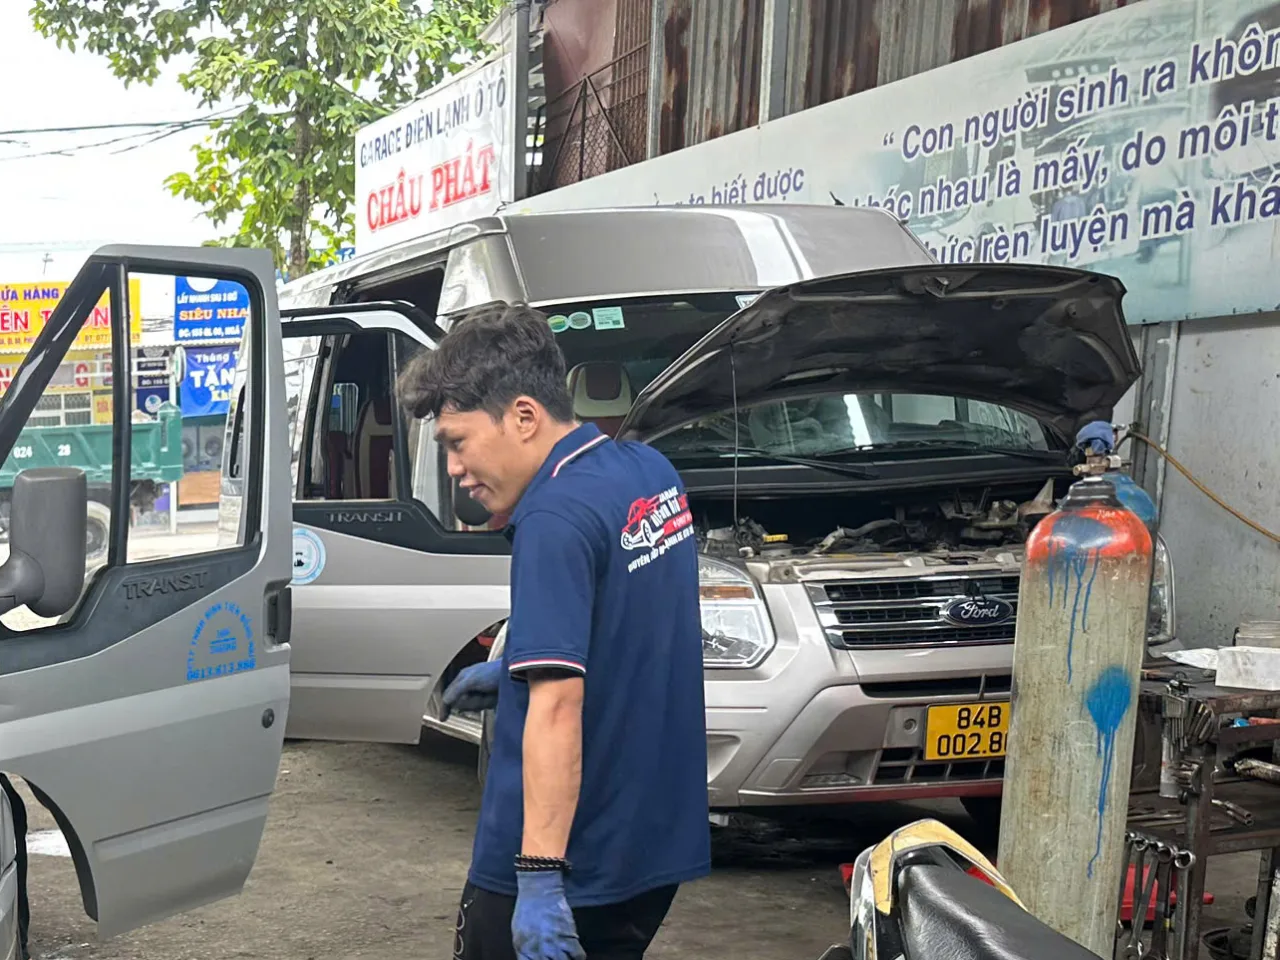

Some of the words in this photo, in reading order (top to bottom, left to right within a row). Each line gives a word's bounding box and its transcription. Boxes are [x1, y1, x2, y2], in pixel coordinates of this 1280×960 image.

[964, 89, 1049, 148] người
[1057, 66, 1128, 118] sinh
[1141, 61, 1176, 98] ra
[360, 127, 401, 168] GARAGE
[920, 180, 987, 219] nhau
[997, 161, 1021, 199] là
[1033, 137, 1108, 192] mấy,
[1122, 132, 1166, 170] do
[1178, 105, 1251, 159] môi
[366, 167, 424, 232] CHÂU
[428, 138, 496, 214] PHÁT
[753, 167, 805, 201] được
[981, 217, 1030, 262] rèn
[1041, 205, 1128, 259] luyện
[1141, 190, 1195, 236] mà
[23, 286, 59, 300] HÀNG
[179, 307, 213, 321] SIÊU
[325, 511, 403, 523] TRANSIT
[122, 571, 208, 601] TRANSIT
[960, 599, 1000, 621] Ford
[956, 704, 1002, 729] 84B
[936, 730, 1008, 757] 002.8
